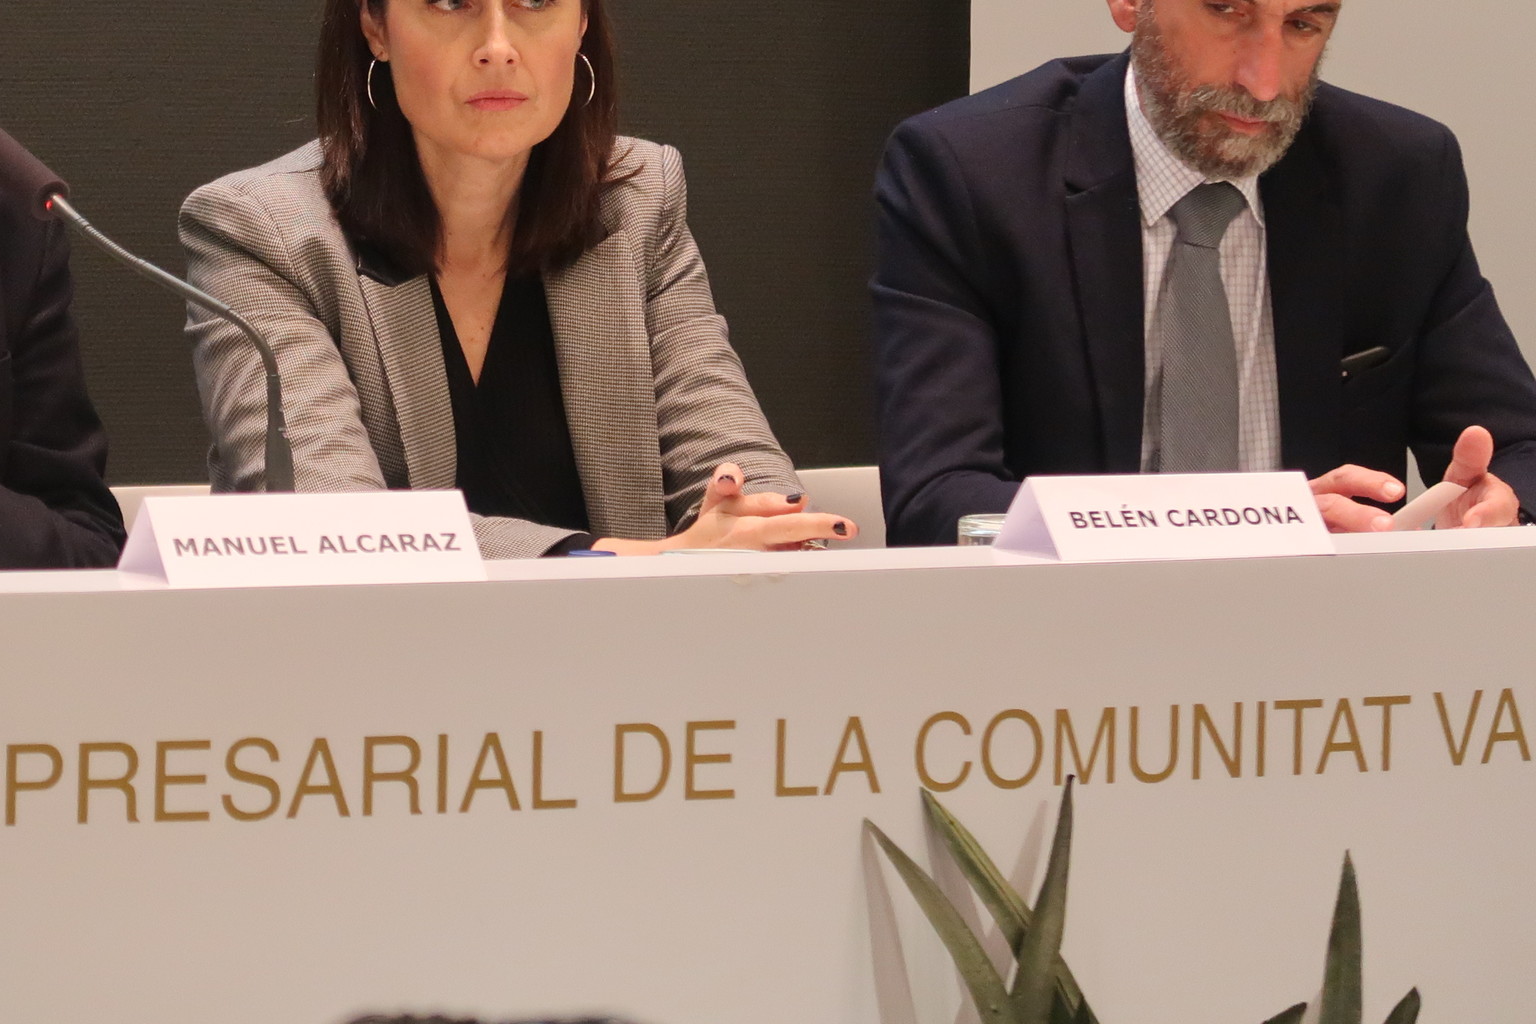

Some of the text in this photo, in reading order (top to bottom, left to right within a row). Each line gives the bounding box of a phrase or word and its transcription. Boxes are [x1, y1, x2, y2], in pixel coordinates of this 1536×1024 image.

[1068, 503, 1305, 530] BELÉN CARDONA
[172, 532, 462, 557] MANUEL ALCARAZ
[612, 719, 738, 805] DE
[772, 716, 883, 798] LA
[913, 693, 1412, 794] COMUNITAT
[1432, 687, 1532, 766] VA
